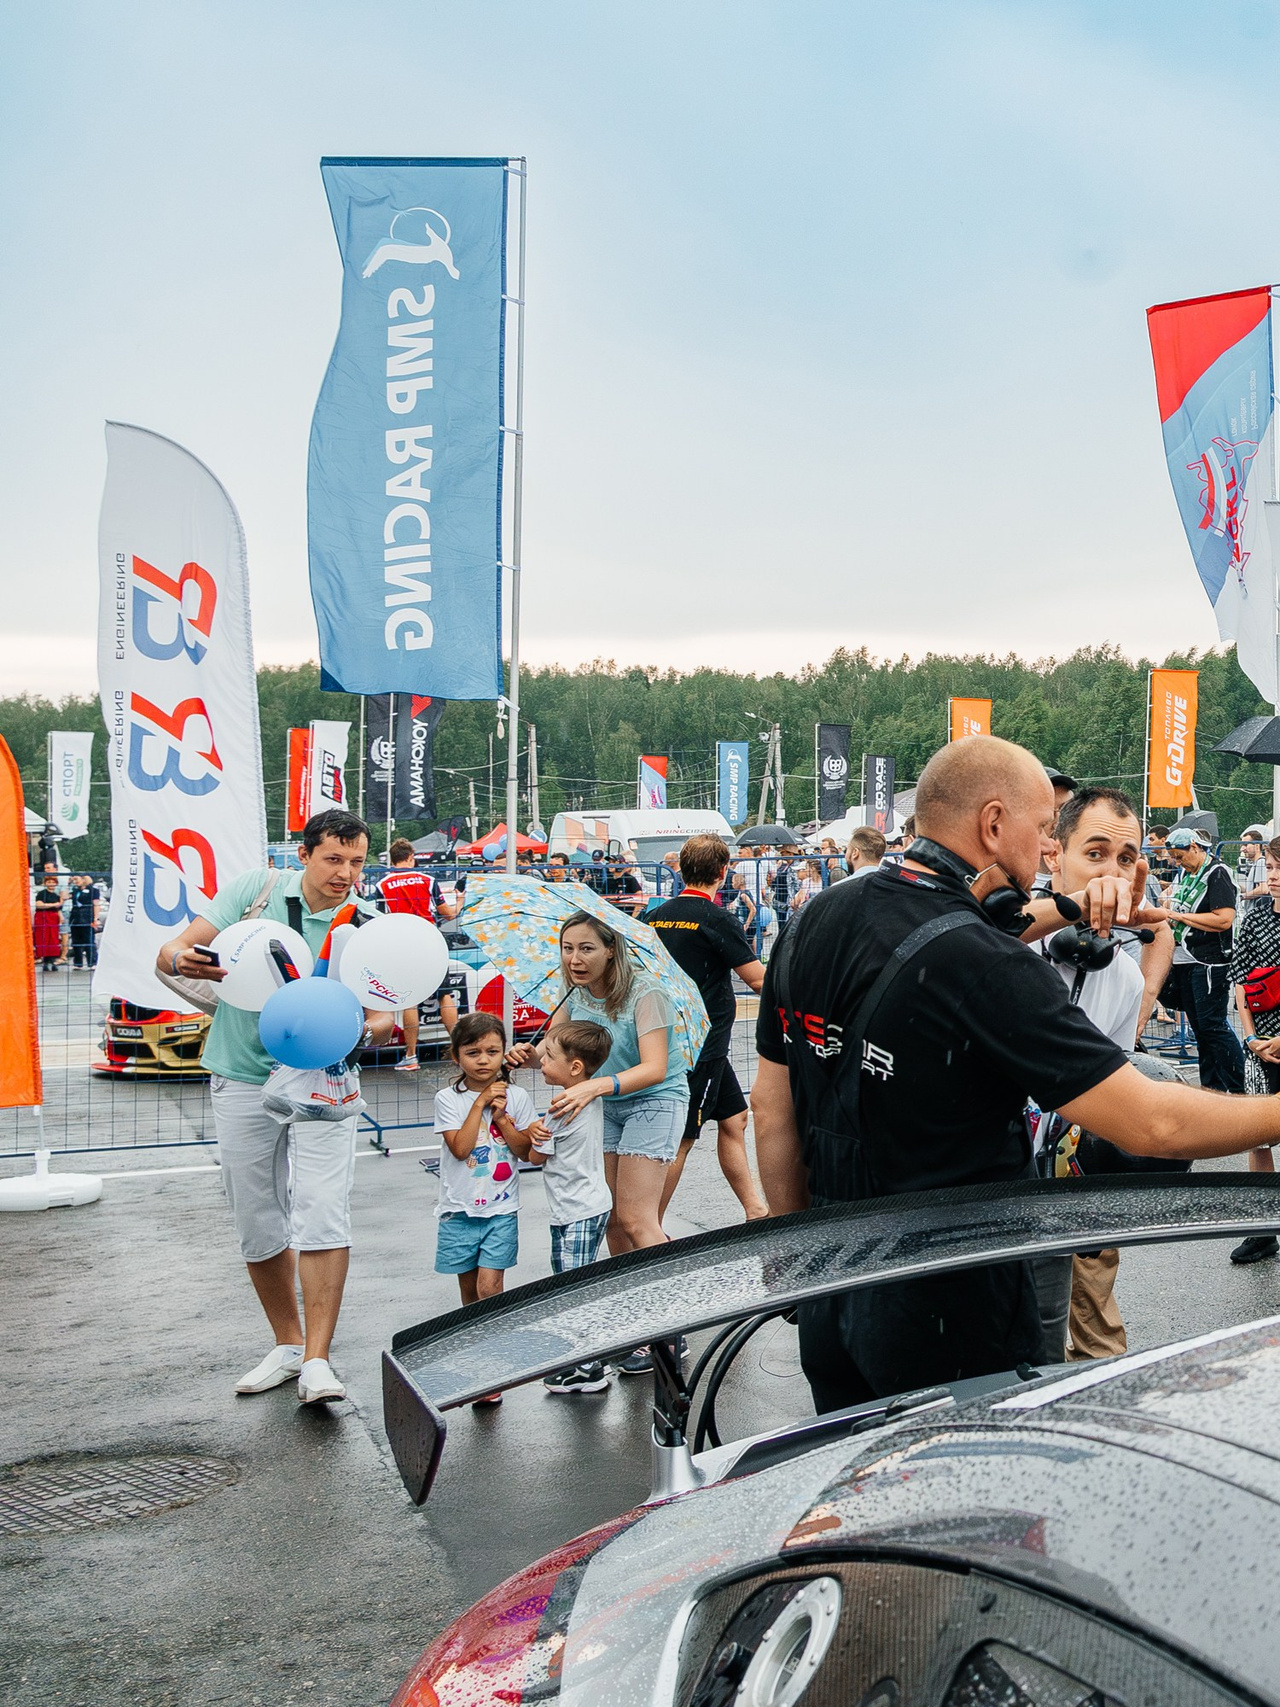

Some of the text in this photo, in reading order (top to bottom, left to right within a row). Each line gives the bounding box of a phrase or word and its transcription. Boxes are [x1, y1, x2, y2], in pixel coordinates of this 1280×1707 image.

[729, 762, 738, 821] SMP RACING
[387, 877, 425, 890] LUKOIL
[675, 921, 700, 930] TEAM
